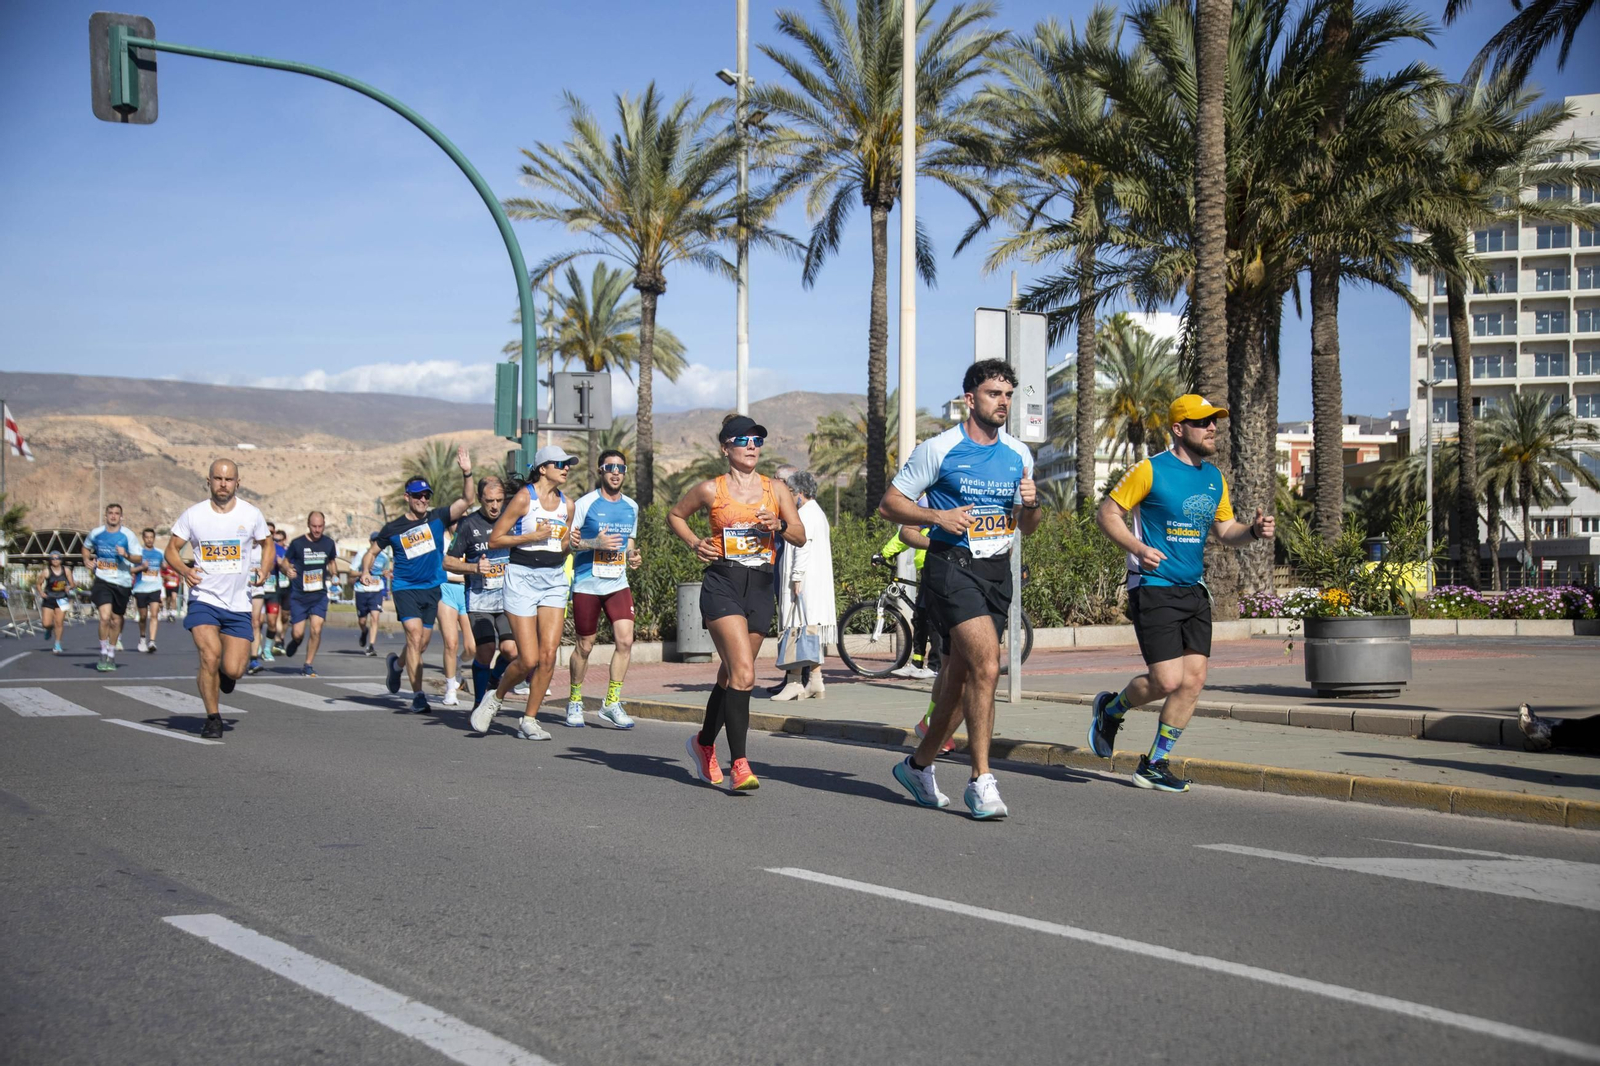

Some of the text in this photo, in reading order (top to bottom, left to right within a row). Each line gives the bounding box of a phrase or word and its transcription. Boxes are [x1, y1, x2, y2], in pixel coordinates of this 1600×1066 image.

[960, 477, 985, 486] Medio
[408, 531, 426, 543] 501
[1166, 527, 1200, 537] solidaria
[205, 545, 238, 557] 2453
[599, 552, 623, 562] 1326
